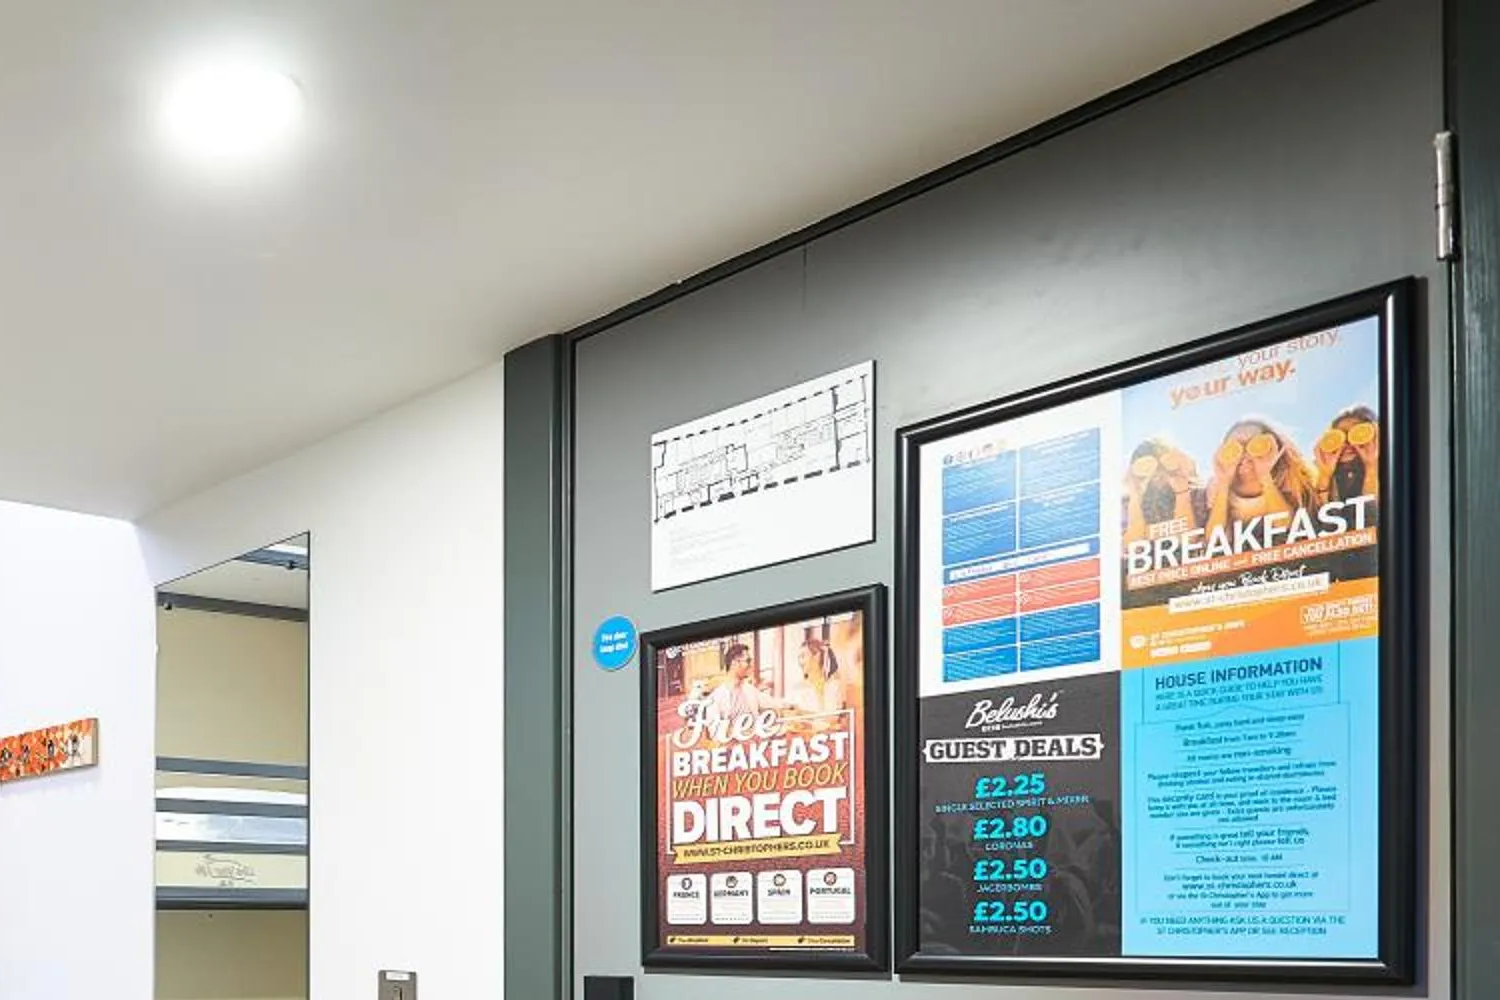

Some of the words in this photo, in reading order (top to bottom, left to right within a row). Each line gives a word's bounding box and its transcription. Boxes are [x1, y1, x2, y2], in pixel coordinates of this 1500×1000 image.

[1237, 346, 1280, 369] your
[1170, 375, 1228, 409] your
[1239, 359, 1296, 386] way.
[1128, 494, 1375, 575] BREAKFAST
[1149, 516, 1188, 539] FREE
[1130, 571, 1154, 587] BEST
[1159, 566, 1188, 583] PRICE
[1191, 559, 1230, 578] ONLINE
[1252, 552, 1280, 566] FREE
[1283, 533, 1373, 560] CANCELLATION
[1155, 671, 1206, 691] HOUSE
[1211, 656, 1323, 684] INFORMATION
[672, 699, 784, 748] Free
[965, 692, 1059, 729] Belushi's
[673, 732, 849, 777] BREAKFAST
[929, 740, 1006, 759] GUEST
[1014, 737, 1097, 757] DEALS
[673, 776, 728, 799] WHEN
[735, 771, 779, 792] YOU
[784, 762, 848, 789] BOOK
[975, 773, 1045, 798] £2.25
[673, 787, 846, 844] DIRECT
[973, 815, 1047, 840] £2.80
[973, 858, 1047, 881] £2.50
[973, 900, 1047, 922] £2.50
